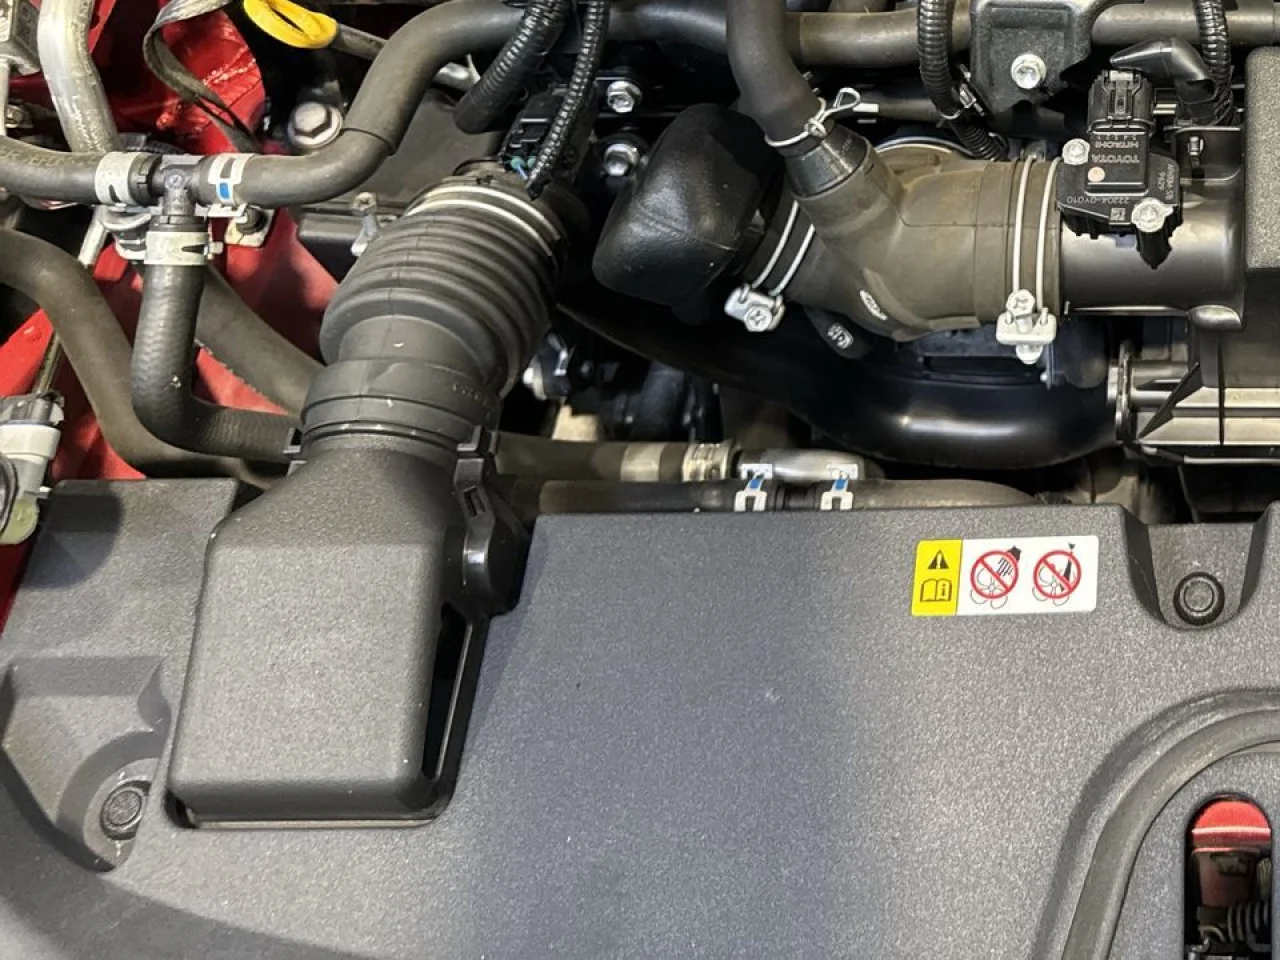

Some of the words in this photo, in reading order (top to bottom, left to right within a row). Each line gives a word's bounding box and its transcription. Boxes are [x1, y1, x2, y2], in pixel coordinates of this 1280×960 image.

[1094, 140, 1140, 149] HITACHI
[1091, 153, 1141, 164] TOYOTA
[1066, 195, 1131, 205] 22204-0Y010
